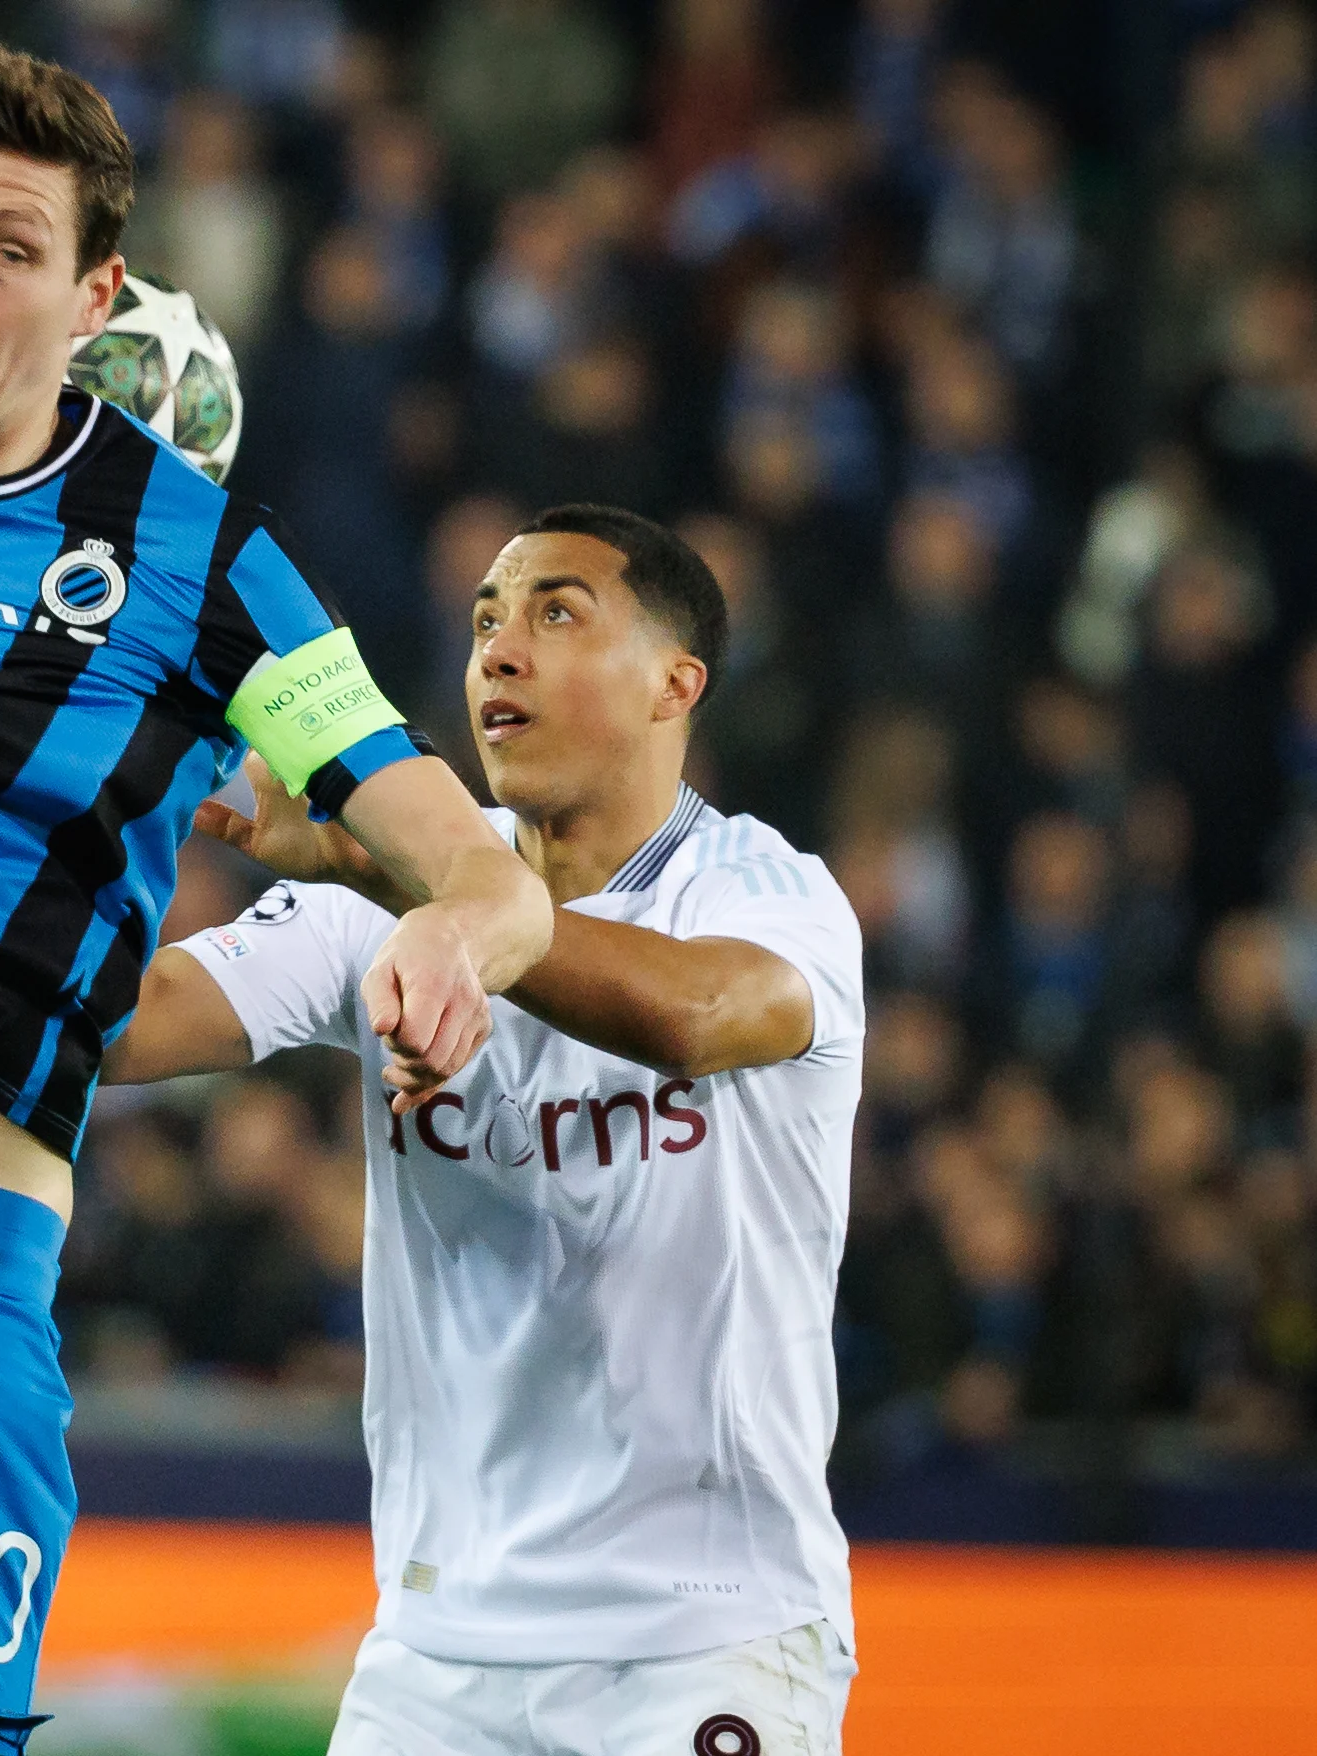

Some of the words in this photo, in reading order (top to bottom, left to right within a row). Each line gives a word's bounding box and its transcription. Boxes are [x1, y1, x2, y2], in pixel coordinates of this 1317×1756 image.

[264, 689, 295, 717] NO
[293, 672, 322, 693] TO
[323, 683, 380, 717] RESPEC
